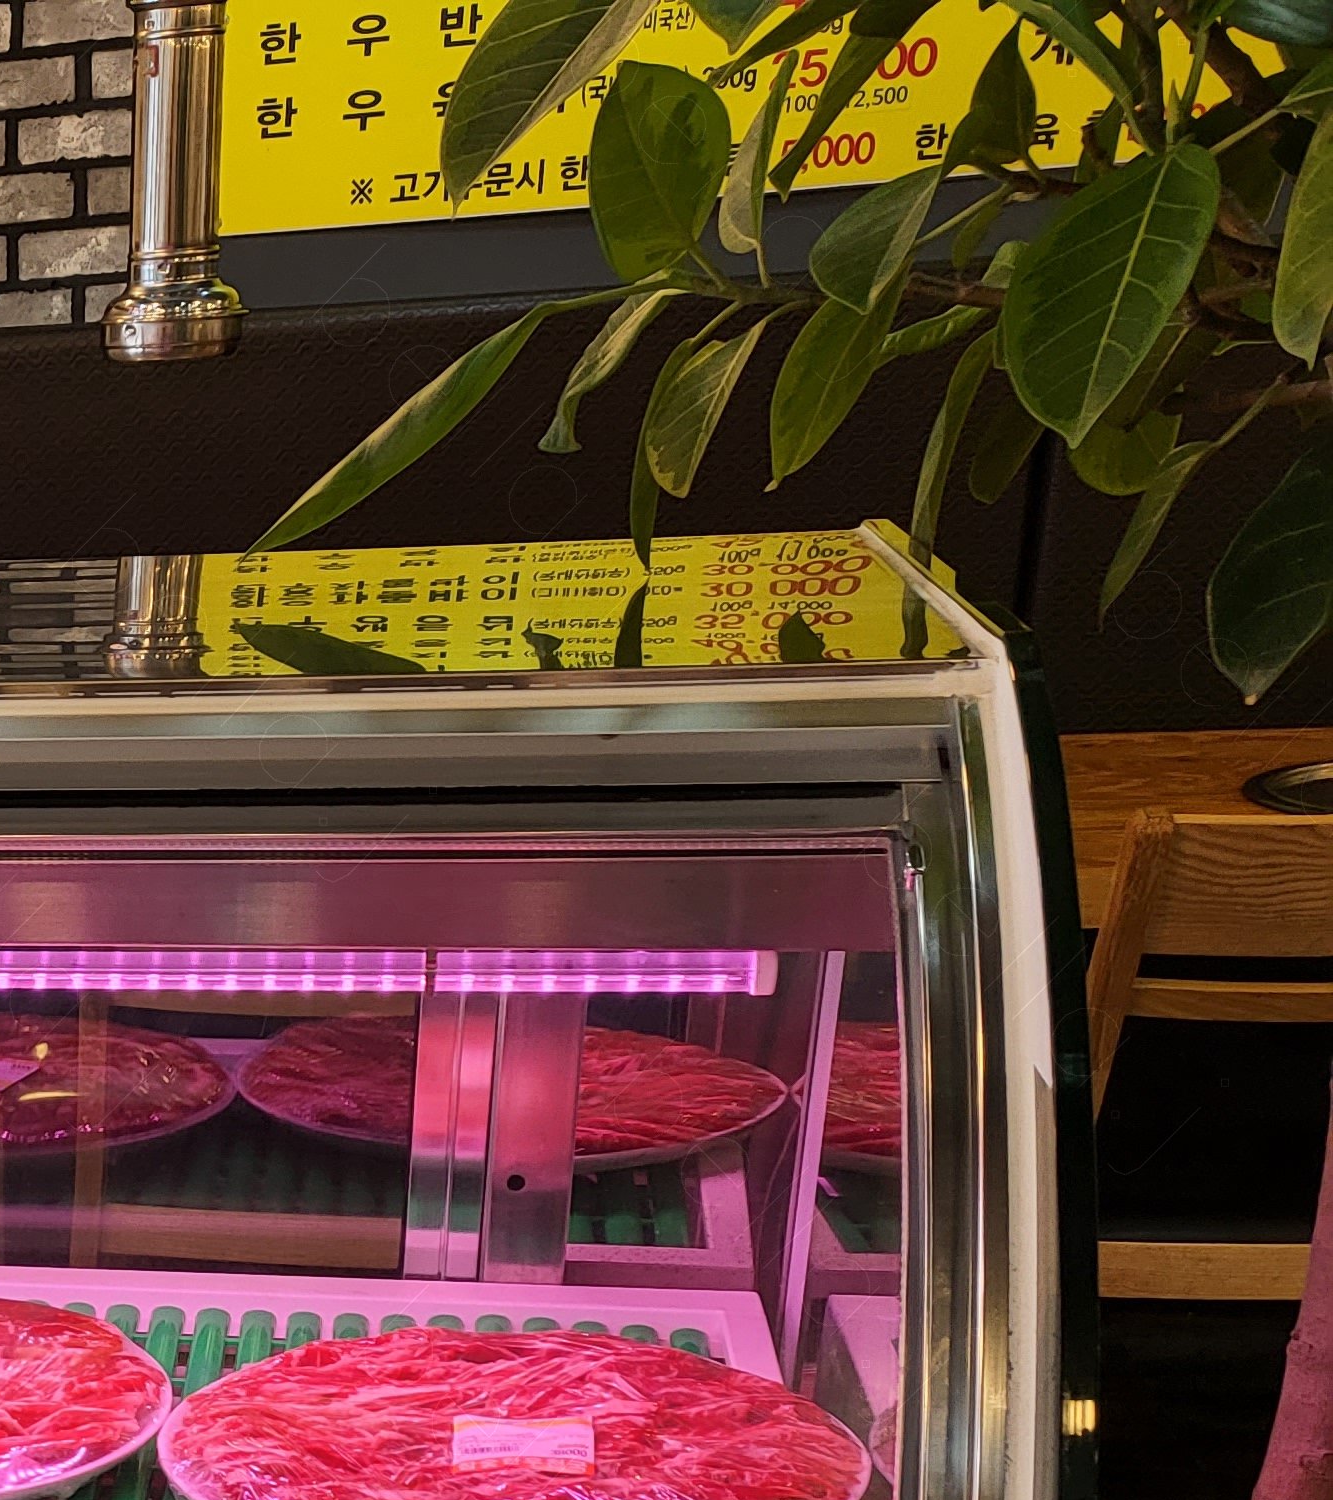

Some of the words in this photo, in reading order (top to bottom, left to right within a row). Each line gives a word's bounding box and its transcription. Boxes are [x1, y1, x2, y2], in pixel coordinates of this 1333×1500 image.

[260, 22, 302, 66] 한
[347, 14, 390, 57] 우
[439, 3, 483, 48] 반
[256, 96, 298, 140] 한
[342, 89, 386, 132] 우
[785, 94, 820, 114] 100
[389, 158, 546, 203] 고기문시
